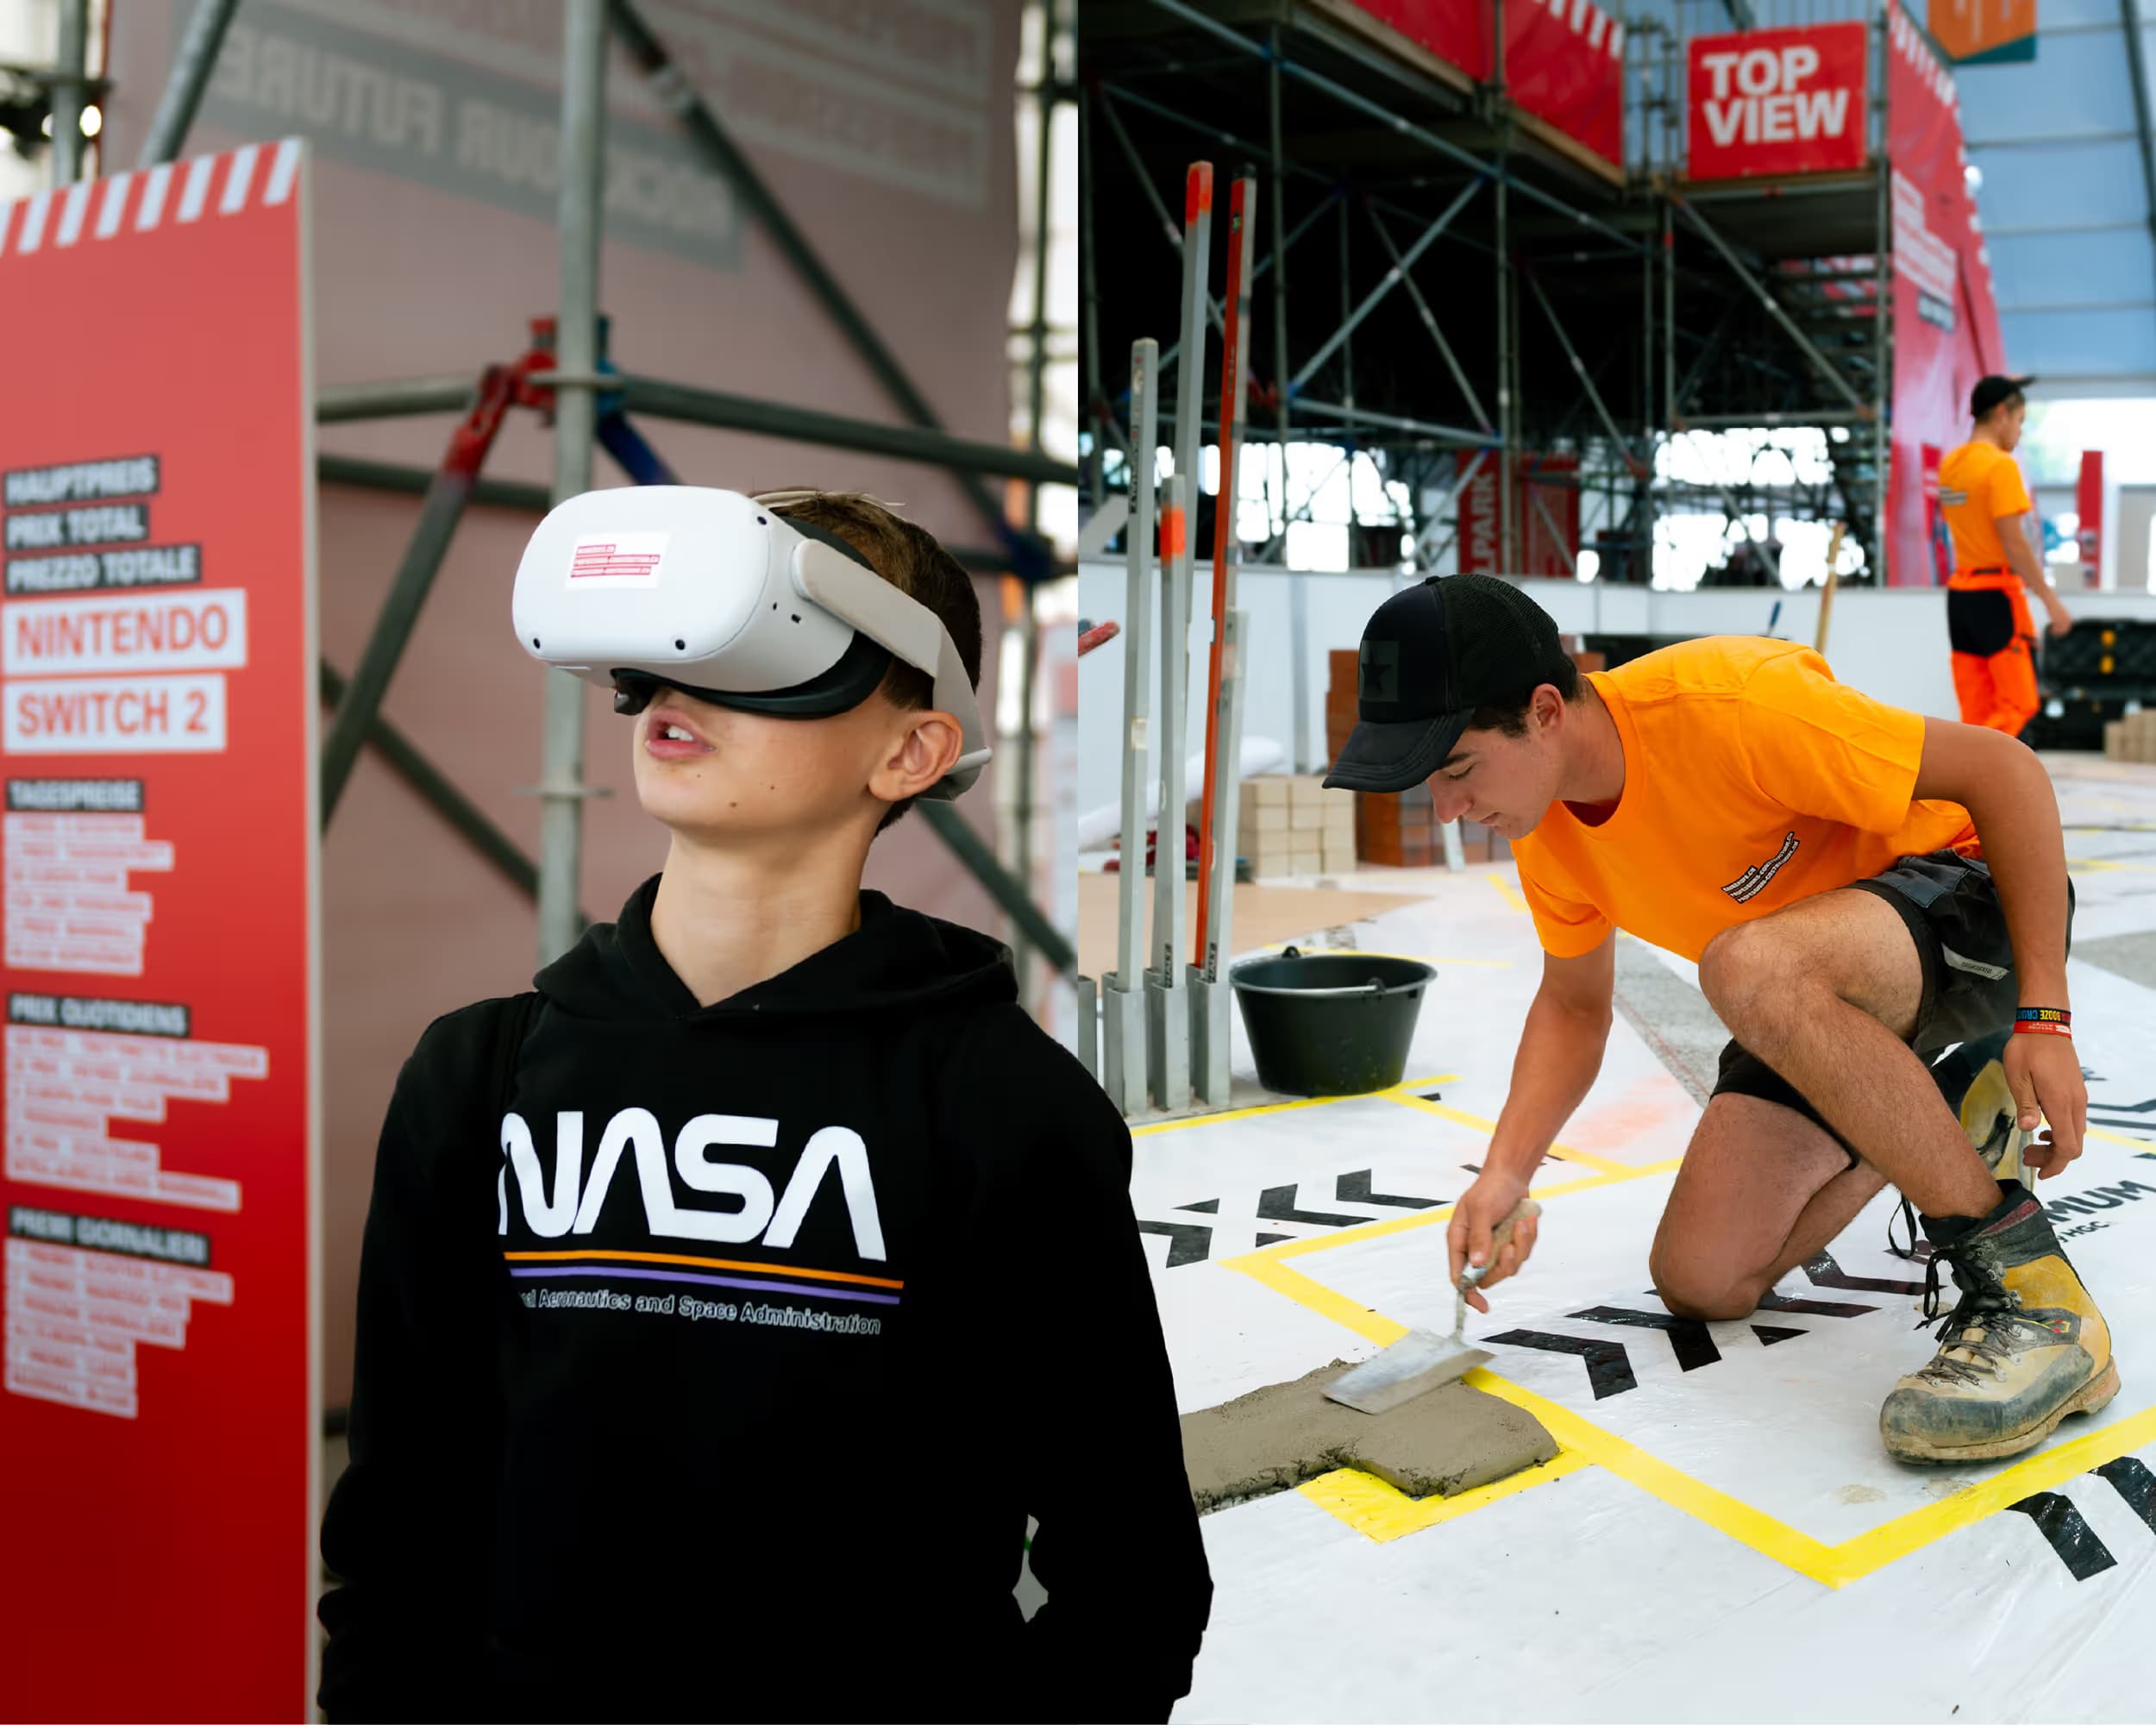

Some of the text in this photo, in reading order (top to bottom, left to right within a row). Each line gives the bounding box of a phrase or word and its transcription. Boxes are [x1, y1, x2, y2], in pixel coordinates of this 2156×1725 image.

[1702, 45, 1820, 100] TOP
[1702, 88, 1849, 147] VIEW
[6, 456, 158, 505] HAUPTPREIS
[7, 505, 145, 549] PRIX TOTAL
[1471, 474, 1495, 574] LPARK
[7, 545, 197, 592] PREZZO TOTALE
[16, 604, 229, 658] NINTENDO
[17, 689, 208, 737] SWITCH 2
[9, 780, 141, 810] TAGESPREISE
[11, 994, 187, 1037] PRIX QUOTIDIENS
[2040, 1009, 2061, 1021] BOOZE
[498, 1107, 887, 1262] NASA
[2044, 1180, 2156, 1225] MUM
[11, 1208, 72, 1245] PREMI
[2060, 1220, 2109, 1238] HGC
[538, 1288, 632, 1310] Aeronautics
[635, 1294, 674, 1314] and
[678, 1295, 737, 1320] Space
[740, 1302, 881, 1334] Administration
